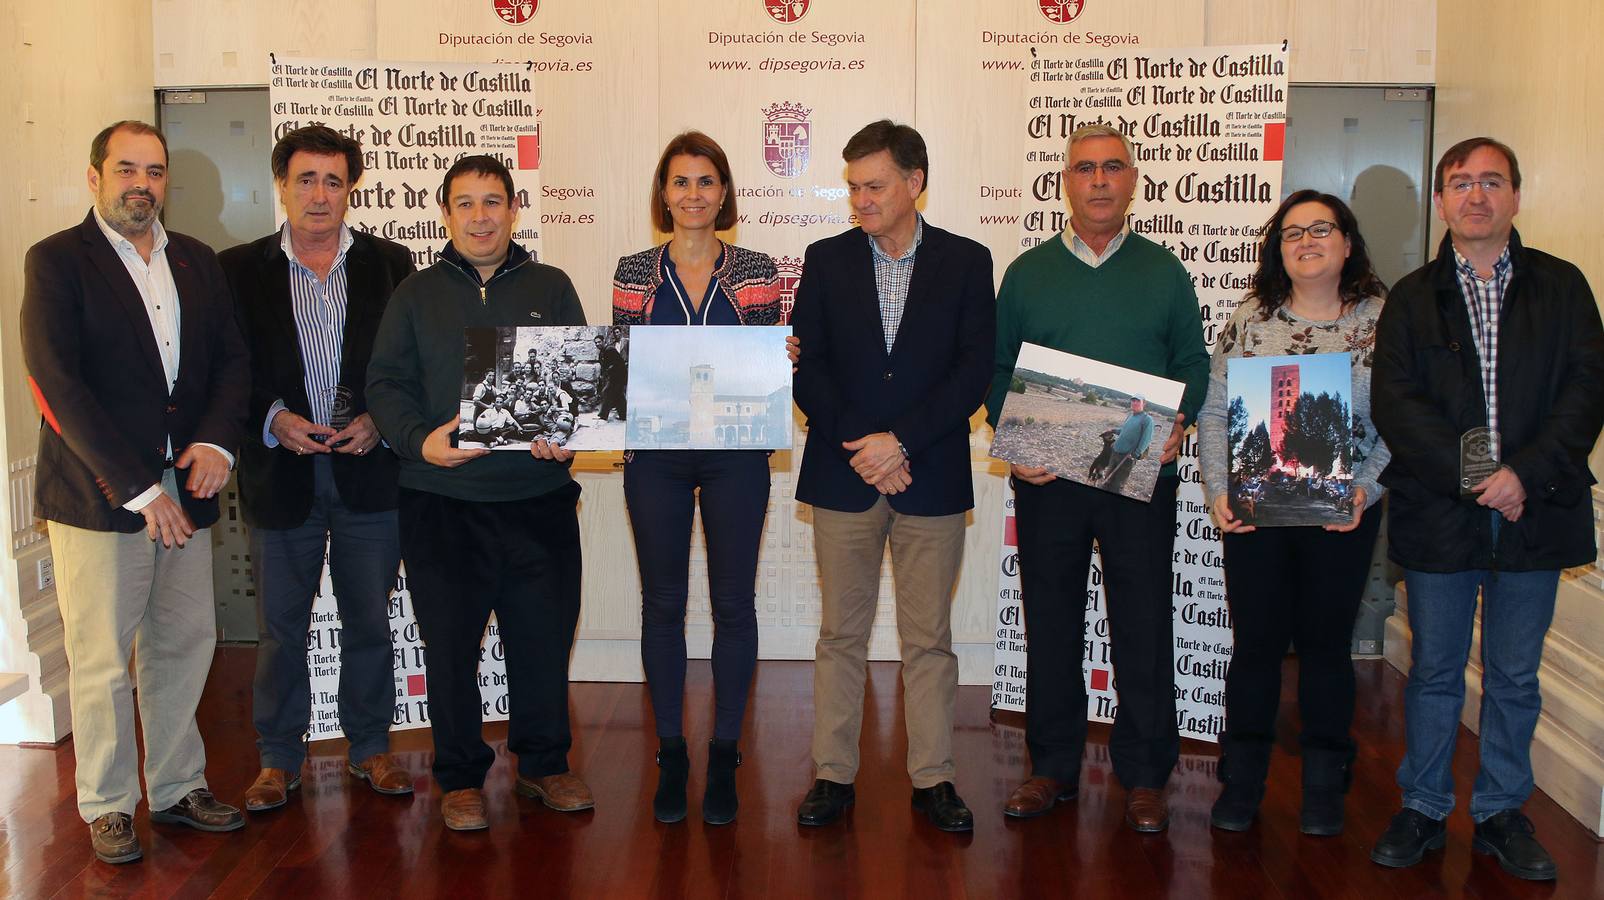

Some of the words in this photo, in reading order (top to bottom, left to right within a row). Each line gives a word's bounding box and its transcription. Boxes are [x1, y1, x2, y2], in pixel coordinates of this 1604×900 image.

[439, 33, 513, 47] Diputación
[518, 33, 535, 45] de
[540, 33, 593, 47] Segovia
[709, 31, 784, 46] Diputación
[789, 31, 806, 43] de
[811, 31, 865, 46] Segovia
[982, 31, 1058, 46] Diputación
[1063, 32, 1080, 44] de
[1085, 32, 1139, 48] Segovia
[271, 64, 282, 75] El
[285, 65, 308, 76] Norte
[310, 66, 319, 76] de
[321, 66, 353, 77] Castilla
[709, 60, 751, 70] www.
[759, 57, 865, 73] dipsegovia.es
[982, 60, 1025, 70] www.
[1030, 59, 1040, 69] El
[1043, 59, 1064, 69] Norte
[1065, 58, 1073, 68] de
[1075, 58, 1104, 69] Castilla
[1106, 57, 1128, 80] El
[1134, 57, 1183, 79] Norte
[1188, 57, 1207, 78] de
[1212, 54, 1284, 78] Castilla
[272, 77, 283, 87] El
[285, 77, 308, 88] Norte
[310, 78, 319, 88] de
[321, 78, 353, 89] Castilla
[355, 67, 378, 90] El
[384, 68, 435, 91] Norte
[439, 71, 458, 91] de
[463, 70, 531, 92] Castilla
[1030, 71, 1040, 82] El
[1043, 71, 1063, 81] Norte
[1065, 71, 1073, 81] de
[1074, 70, 1104, 81] Castilla
[1029, 96, 1041, 108] El
[1045, 96, 1070, 109] Norte
[1073, 97, 1082, 108] de
[1085, 95, 1122, 108] Castilla
[1126, 85, 1145, 106] El
[1152, 85, 1195, 105] Norte
[1200, 86, 1216, 104] de
[1220, 83, 1284, 104] Castilla
[273, 102, 286, 115] El
[290, 102, 318, 115] Norte
[321, 104, 331, 116] de
[334, 104, 374, 117] Castilla
[378, 96, 398, 115] El
[403, 96, 447, 116] Norte
[451, 99, 468, 116] de
[473, 98, 533, 117] Castilla
[1027, 113, 1051, 139] El
[1117, 115, 1138, 137] de
[1143, 113, 1221, 138] Castilla
[370, 124, 392, 147] de
[397, 123, 477, 148] Castilla
[1026, 151, 1036, 162] El
[1040, 151, 1060, 162] Norte
[1176, 143, 1192, 162] de
[1197, 142, 1259, 162] Castilla
[363, 151, 379, 170] El
[385, 151, 428, 170] Norte
[433, 153, 449, 171] de
[541, 185, 594, 200] Segovia
[980, 185, 1022, 200] Diput
[1032, 171, 1061, 201] El
[1143, 174, 1168, 202] de
[1175, 171, 1272, 204] Castilla
[350, 181, 396, 210] orte
[402, 182, 429, 210] de
[540, 211, 594, 224] ovia.es
[759, 211, 860, 227] dipsegovia.e
[980, 215, 1019, 224] www
[1023, 211, 1044, 231] El
[382, 220, 448, 240] Castilla
[511, 229, 539, 240] astilla
[1188, 224, 1199, 236] El
[1203, 224, 1227, 236] Norte
[1229, 226, 1239, 236] de
[1180, 240, 1198, 262] de
[1204, 240, 1262, 263] Castill
[1202, 272, 1216, 288] de
[1186, 501, 1210, 514] Norte
[1184, 548, 1198, 565] de
[999, 588, 1010, 600] El
[311, 611, 334, 623] Norte
[999, 605, 1019, 626] El
[997, 628, 1007, 638] El
[996, 640, 1006, 650] El
[1176, 636, 1200, 651] Norte
[1202, 641, 1211, 653] de
[1213, 643, 1232, 656] Cast
[313, 654, 336, 665] Norte
[1177, 654, 1229, 680] Castil
[314, 666, 337, 677] Norte
[492, 671, 506, 687] de
[994, 664, 1007, 676] El
[1010, 665, 1026, 679] Nor
[993, 681, 1003, 691] El
[1005, 682, 1026, 694] Norte
[993, 692, 1002, 703] El
[1004, 694, 1024, 706] Norte
[1191, 686, 1226, 707] Casti
[317, 709, 339, 720] Norte
[393, 702, 411, 725] El
[318, 722, 340, 733] Norte
[1176, 709, 1224, 736] Castil
